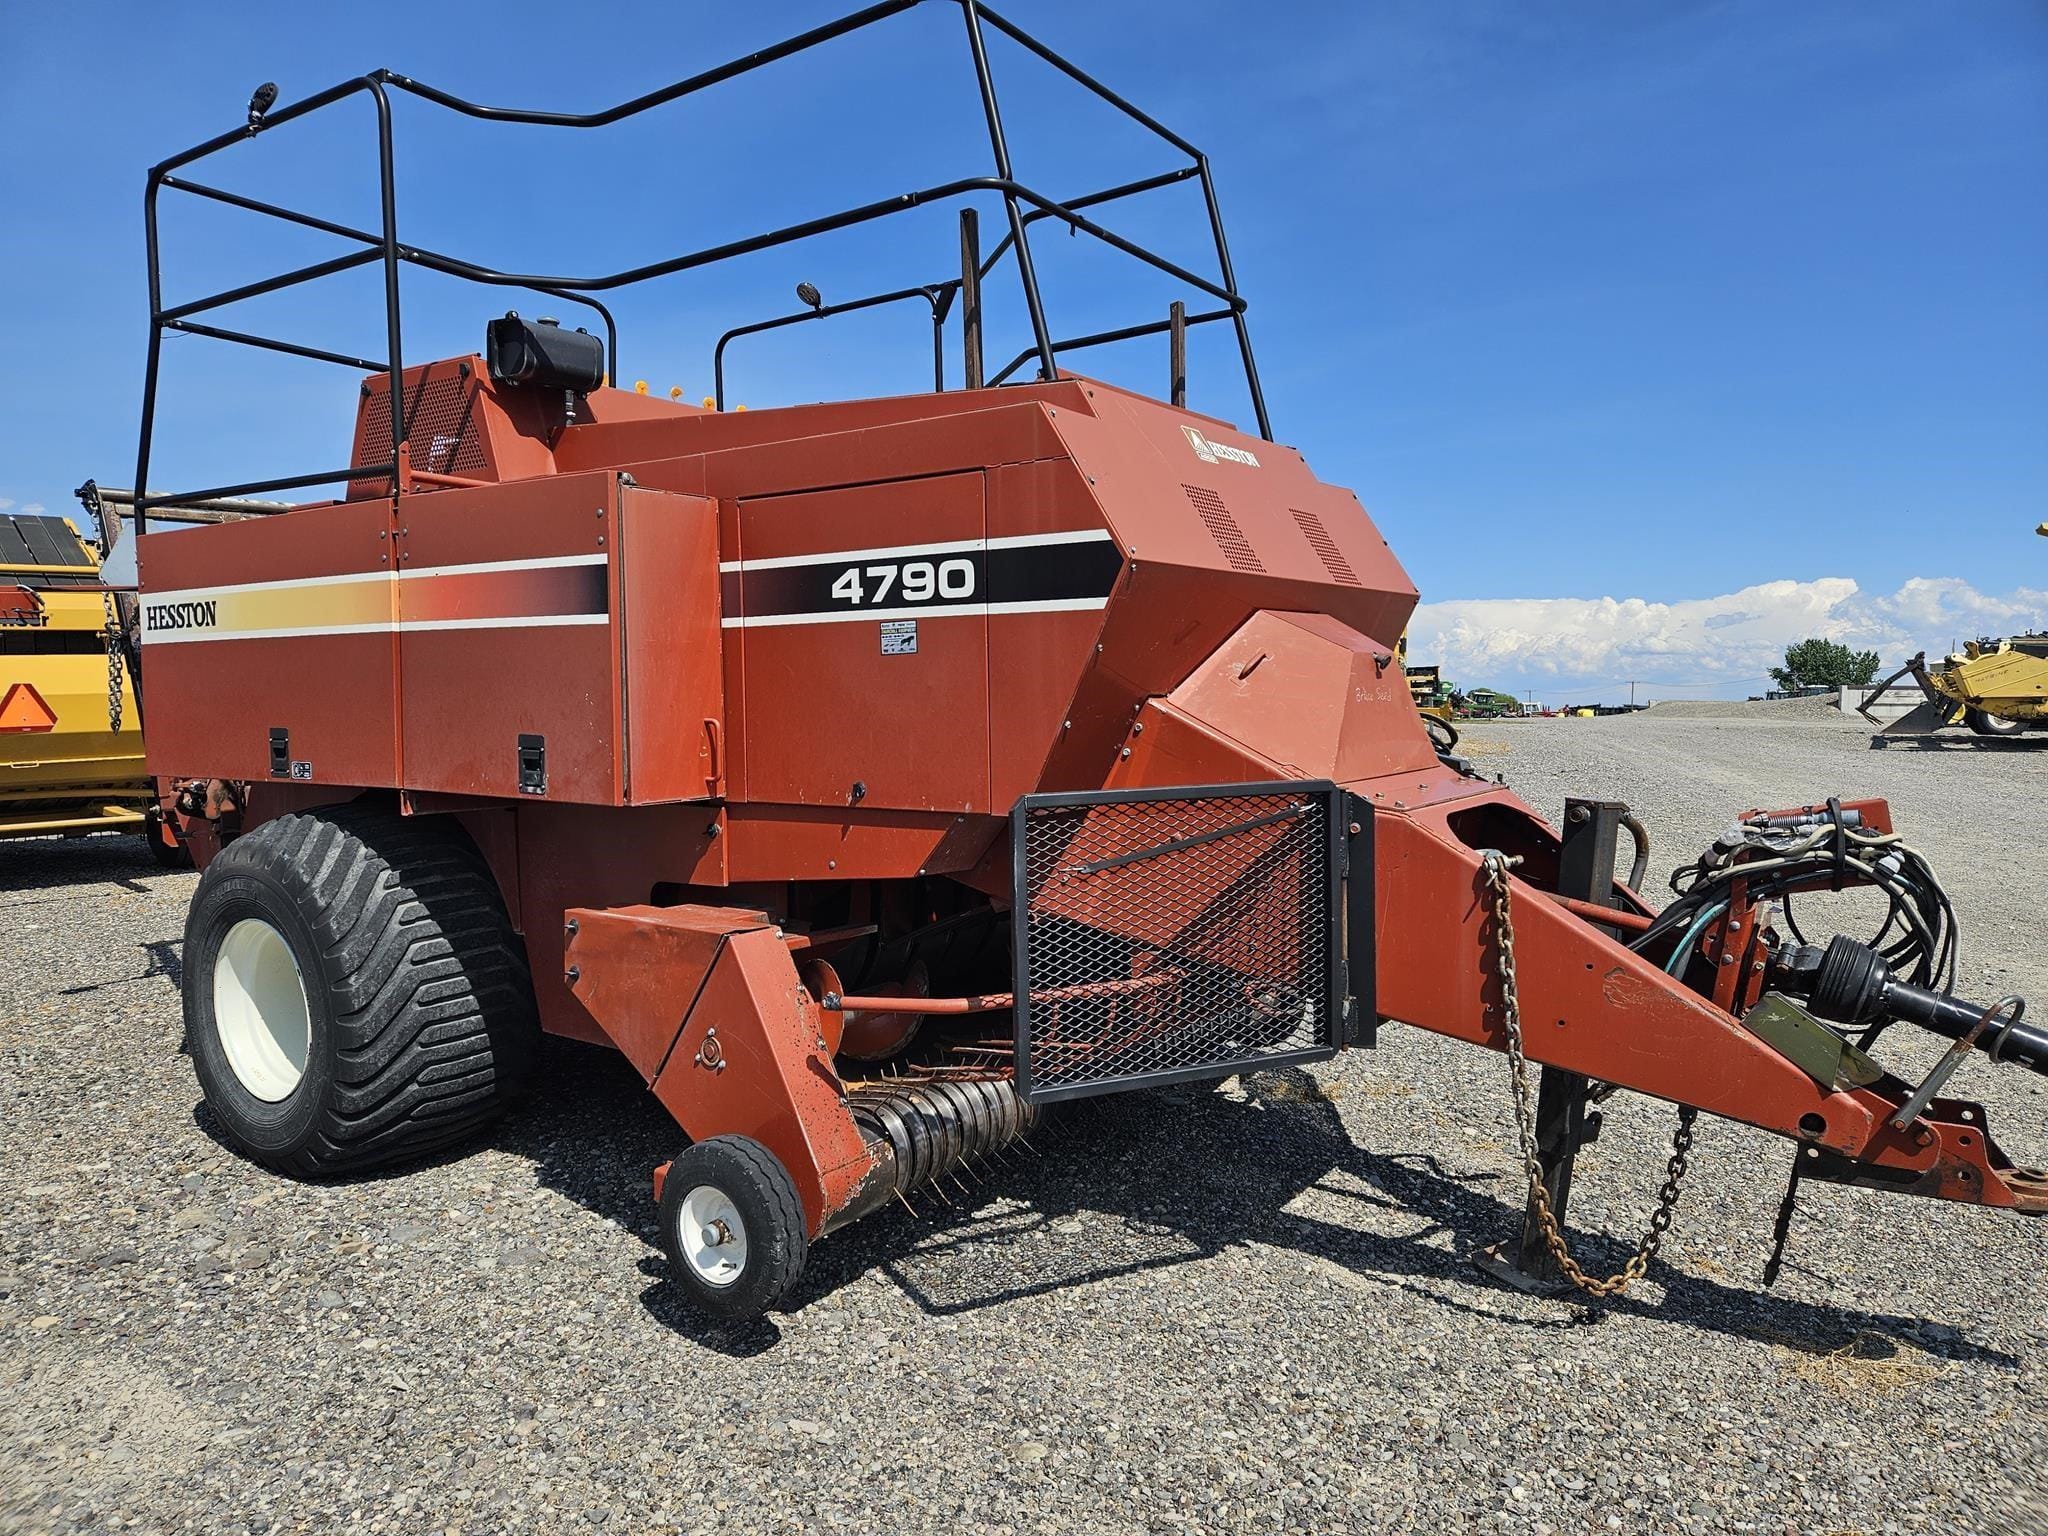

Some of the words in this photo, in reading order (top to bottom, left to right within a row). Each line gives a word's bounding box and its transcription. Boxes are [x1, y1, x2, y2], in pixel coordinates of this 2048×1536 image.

[1207, 440, 1260, 467] HESSTON
[831, 558, 975, 604] 4790
[146, 600, 217, 631] HESSTON
